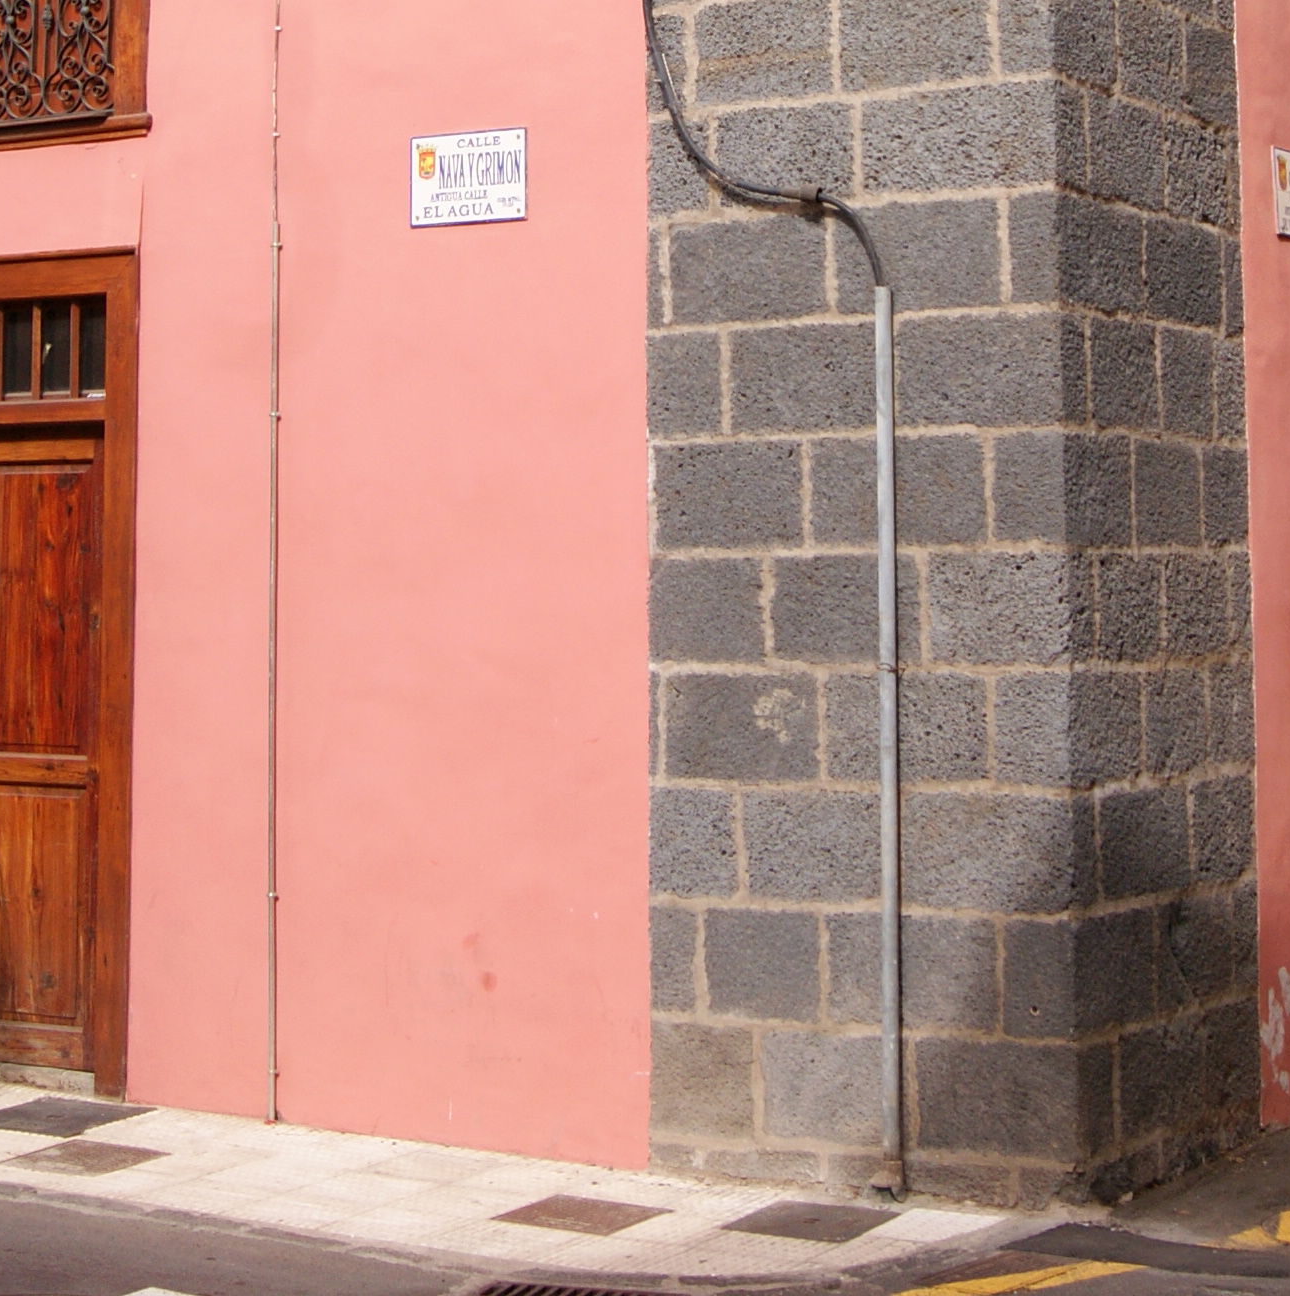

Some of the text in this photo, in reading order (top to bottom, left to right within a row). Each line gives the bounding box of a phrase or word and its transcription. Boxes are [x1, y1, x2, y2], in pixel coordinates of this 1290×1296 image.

[457, 136, 501, 148] CALLE
[438, 154, 465, 189] NAVA
[468, 153, 475, 187] Y
[464, 190, 488, 200] CALLE
[423, 203, 494, 218] EL AGUA
